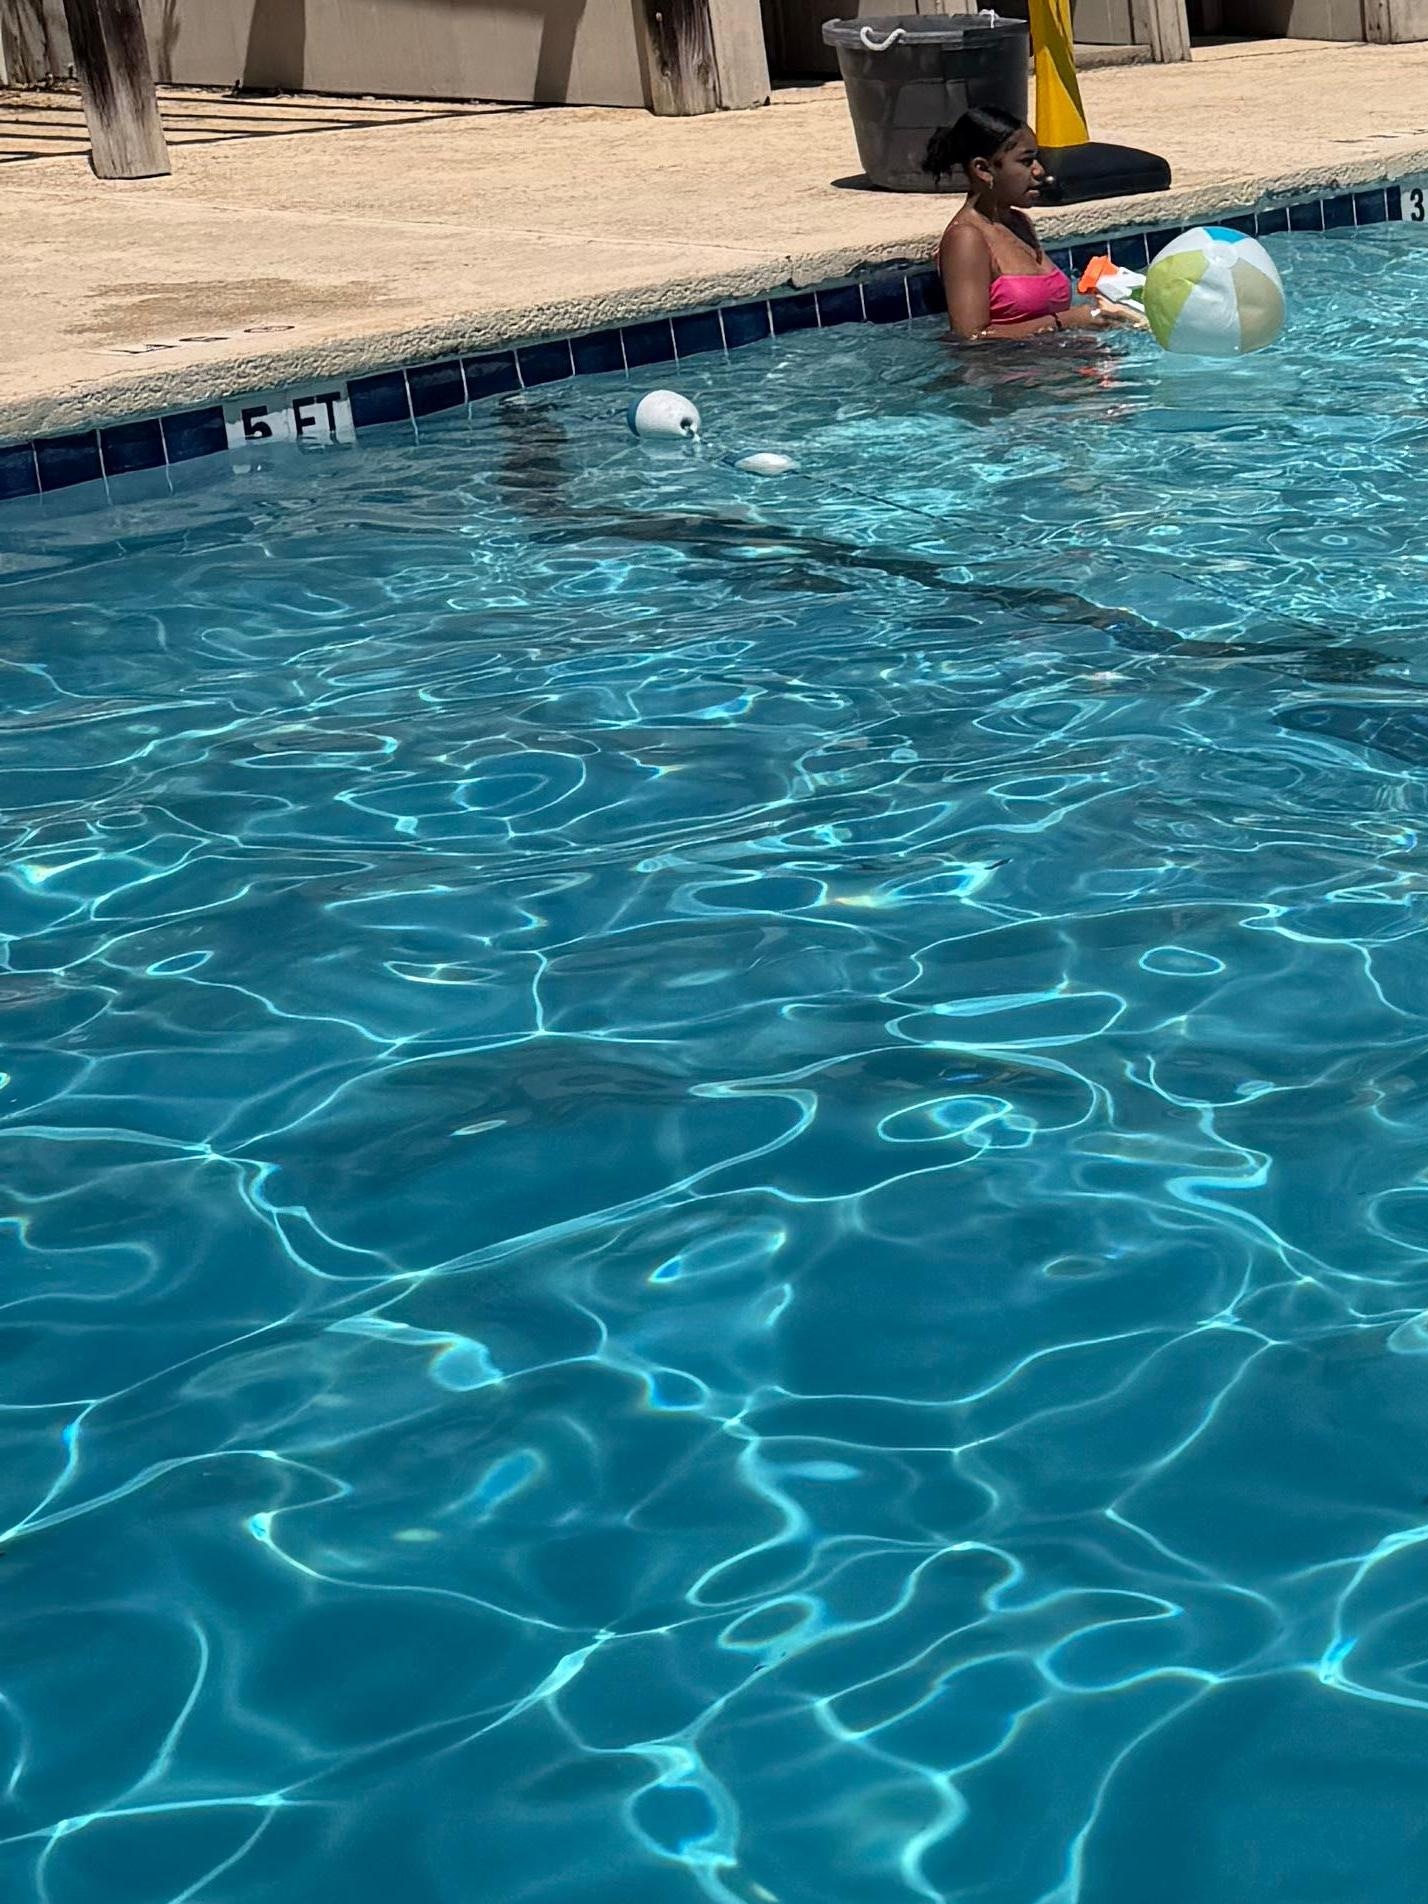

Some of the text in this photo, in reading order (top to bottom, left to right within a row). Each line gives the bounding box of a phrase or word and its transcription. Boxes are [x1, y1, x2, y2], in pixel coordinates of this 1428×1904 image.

[1410, 188, 1425, 222] 3
[241, 391, 341, 441] 5 FT
